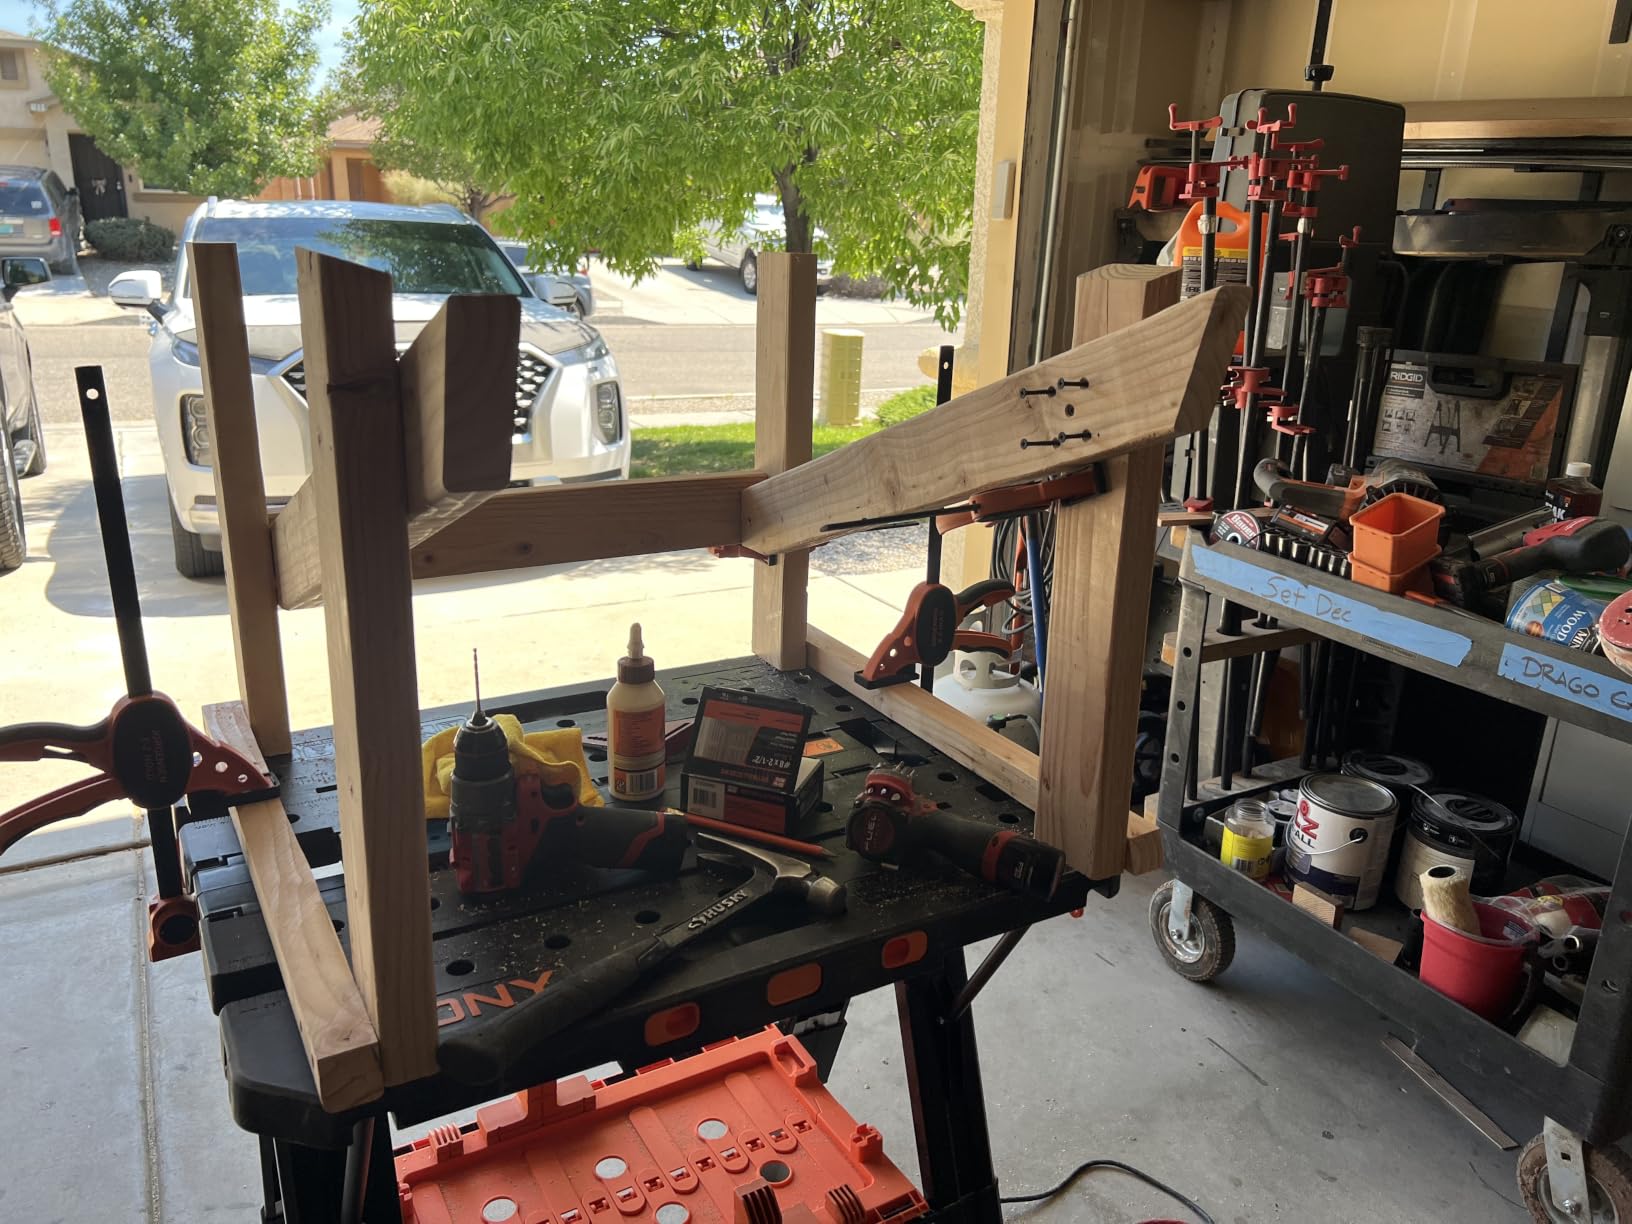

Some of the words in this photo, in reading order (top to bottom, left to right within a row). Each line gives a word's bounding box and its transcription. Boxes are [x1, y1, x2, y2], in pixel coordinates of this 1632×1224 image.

[1391, 371, 1423, 383] RIDGID
[1231, 514, 1257, 537] Bauer
[1261, 576, 1306, 608] Set
[1315, 588, 1353, 624] Dec
[1557, 610, 1588, 642] WOOD
[1521, 656, 1600, 698] DRAGO
[702, 888, 749, 924] HUSKY
